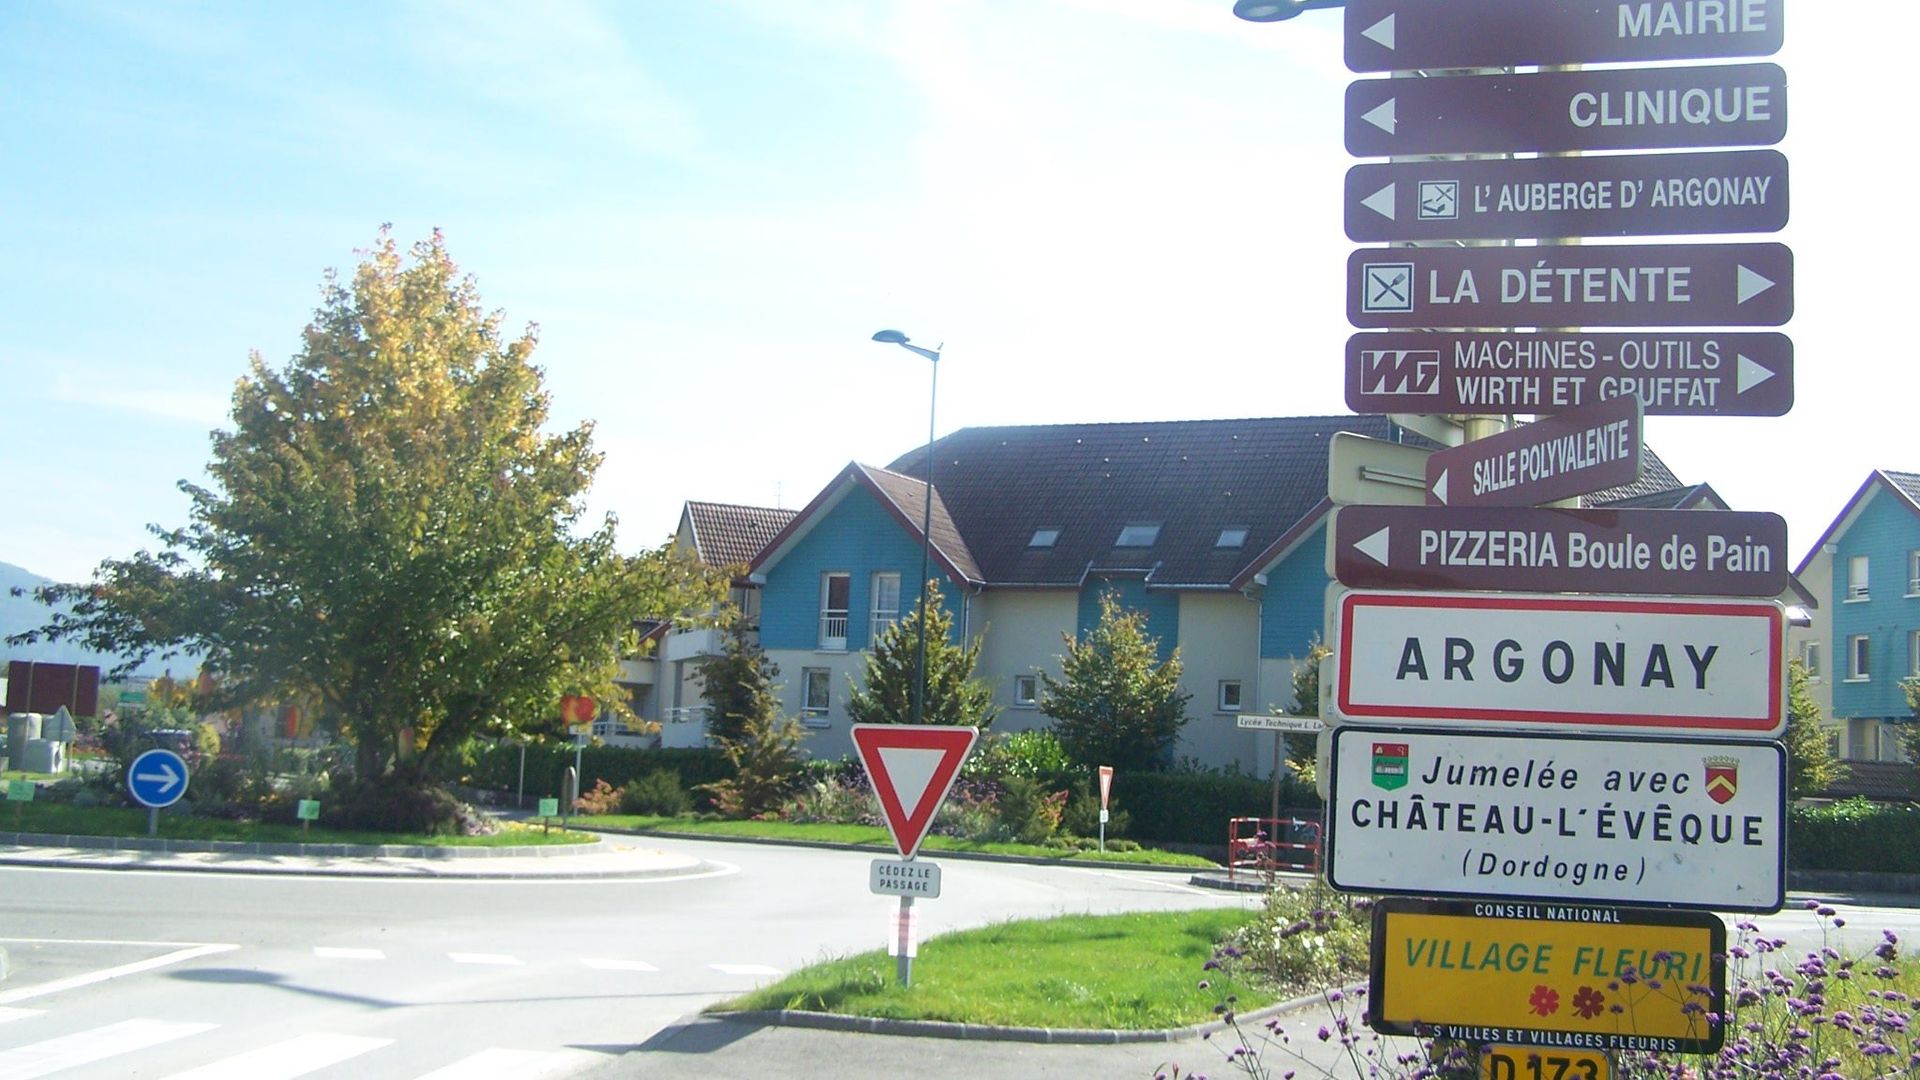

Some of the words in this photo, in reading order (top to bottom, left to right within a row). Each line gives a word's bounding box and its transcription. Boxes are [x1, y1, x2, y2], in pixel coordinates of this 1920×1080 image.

[1618, 0, 1767, 38] MAIRIE
[1569, 86, 1771, 127] CLINIQUE
[1498, 180, 1612, 212] AUBERGE
[1651, 176, 1771, 208] ARGONAY
[1429, 269, 1479, 303] LA
[1501, 261, 1691, 303] DÉTENTE
[1456, 376, 1540, 404] WIRTH
[1553, 377, 1586, 405] ET
[1473, 451, 1516, 496] SALLE
[1520, 419, 1629, 483] POLYVALENTE
[1420, 530, 1558, 567] PIZZERIA
[1568, 532, 1652, 569] Boule
[1660, 535, 1696, 570] de
[1706, 535, 1770, 572] Pain
[1396, 637, 1719, 689] ARGONAY
[1265, 718, 1302, 730] Technique
[1422, 756, 1579, 788] Jumelée
[1604, 767, 1690, 794] avec
[879, 864, 914, 877] CÉDEZ
[918, 868, 930, 878] LE
[880, 878, 928, 891] PASSAGE
[1461, 848, 1646, 885] (Dordogne)
[1475, 904, 1541, 919] CONSEIL
[1547, 908, 1621, 923] NATIONAL
[1405, 938, 1553, 974] VILLAGE
[1572, 946, 1703, 982] FLEURI
[1449, 1026, 1500, 1041] VILLES
[1507, 1030, 1523, 1043] ET
[1531, 1031, 1603, 1047] VILLAGES
[1610, 1036, 1676, 1051] FLEURIS
[1527, 1056, 1598, 1080] 173
